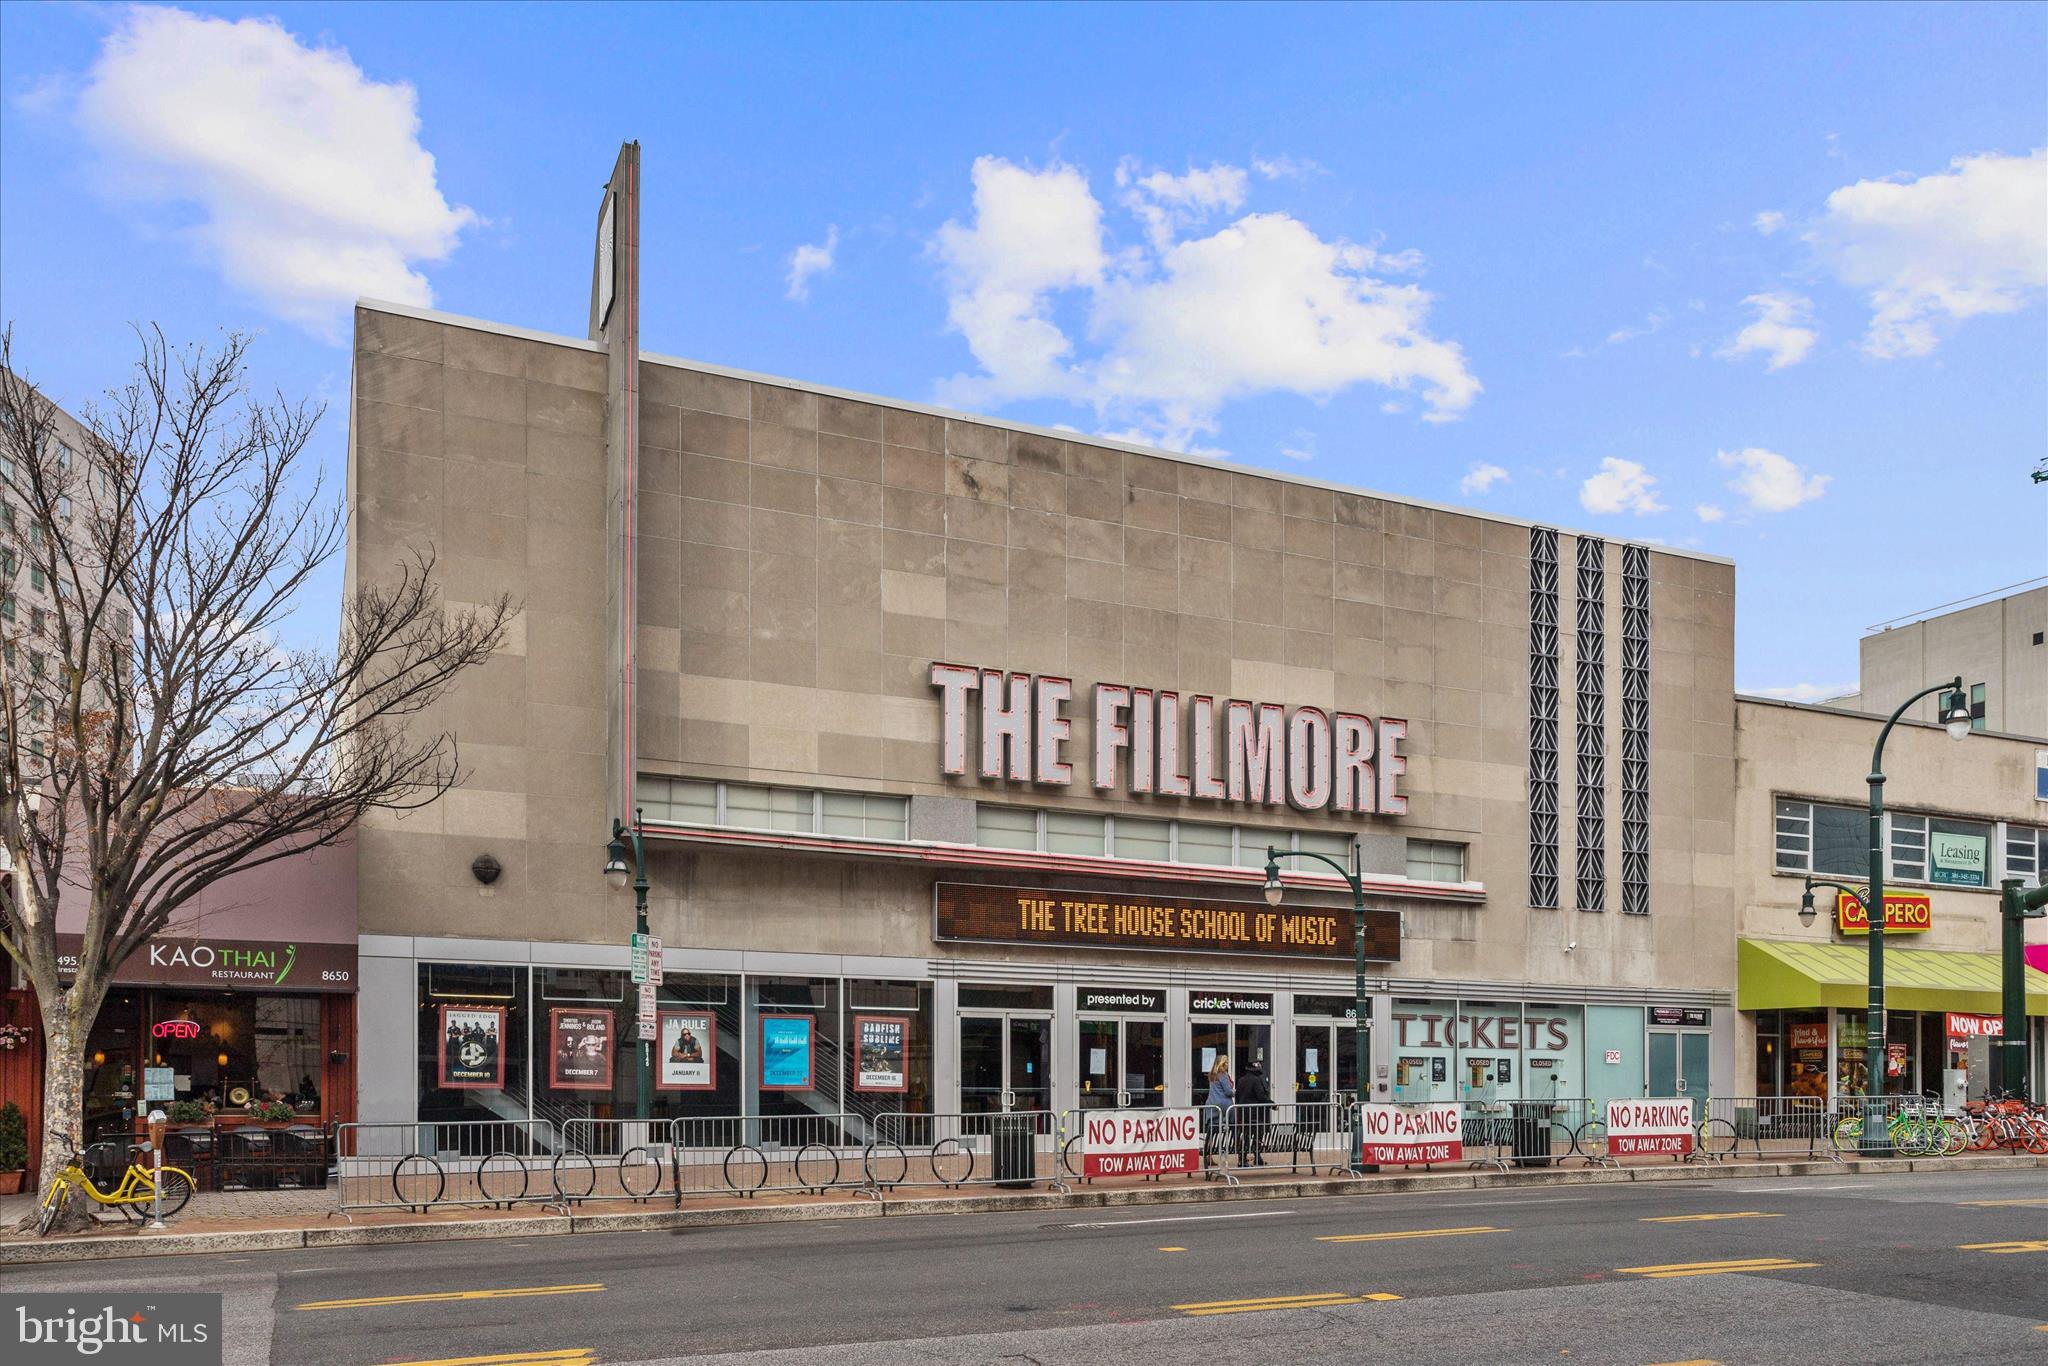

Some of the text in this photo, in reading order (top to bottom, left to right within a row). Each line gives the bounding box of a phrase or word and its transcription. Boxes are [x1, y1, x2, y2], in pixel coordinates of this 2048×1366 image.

[928, 662, 1409, 816] THE FILLMORE
[1941, 843, 1980, 864] Leasing
[1845, 902, 1929, 923] CAPERO
[1018, 899, 1337, 945] THE TREE HOUSE SCHOOL OF MUSIC
[652, 941, 659, 949] NO
[212, 970, 274, 980] RESTAURANT
[322, 971, 349, 981] 8650
[1087, 994, 1156, 1007] presented by
[1193, 998, 1269, 1010] cricket wireless
[152, 1023, 197, 1039] OPEN
[665, 1019, 706, 1030] JA RULE
[864, 1023, 900, 1033] BADFISH
[1392, 1014, 1569, 1050] TICKETS
[1951, 1016, 2003, 1035] NOW OP
[863, 1034, 900, 1044] SUBLIME
[1607, 1052, 1619, 1061] FDC
[1367, 1110, 1457, 1135] NO PARKING
[1611, 1106, 1689, 1128] NO PARKING
[1089, 1116, 1195, 1145] NO PARKING
[1374, 1145, 1449, 1161] TOW AWAY ZONE
[1619, 1138, 1681, 1152] TOW AWAY ZONE
[1099, 1153, 1185, 1173] TOW AWAY ZONE
